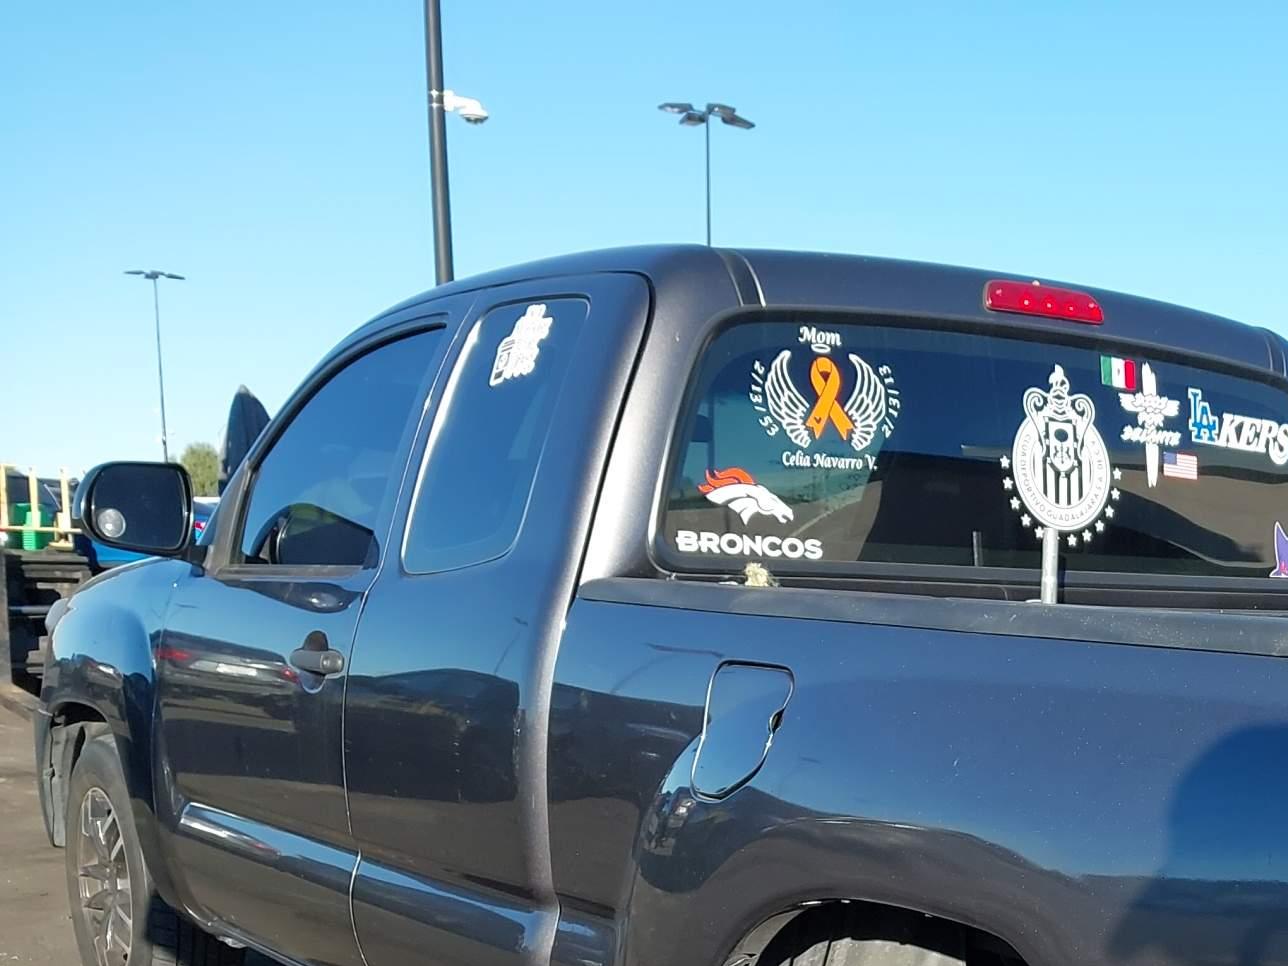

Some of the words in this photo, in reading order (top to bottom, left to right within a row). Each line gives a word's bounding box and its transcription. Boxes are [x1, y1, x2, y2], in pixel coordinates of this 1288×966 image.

[798, 326, 841, 347] Mom
[782, 450, 812, 467] Celia
[813, 452, 863, 470] Navarro
[864, 454, 878, 471] V.
[675, 530, 823, 560] BRONCOS
